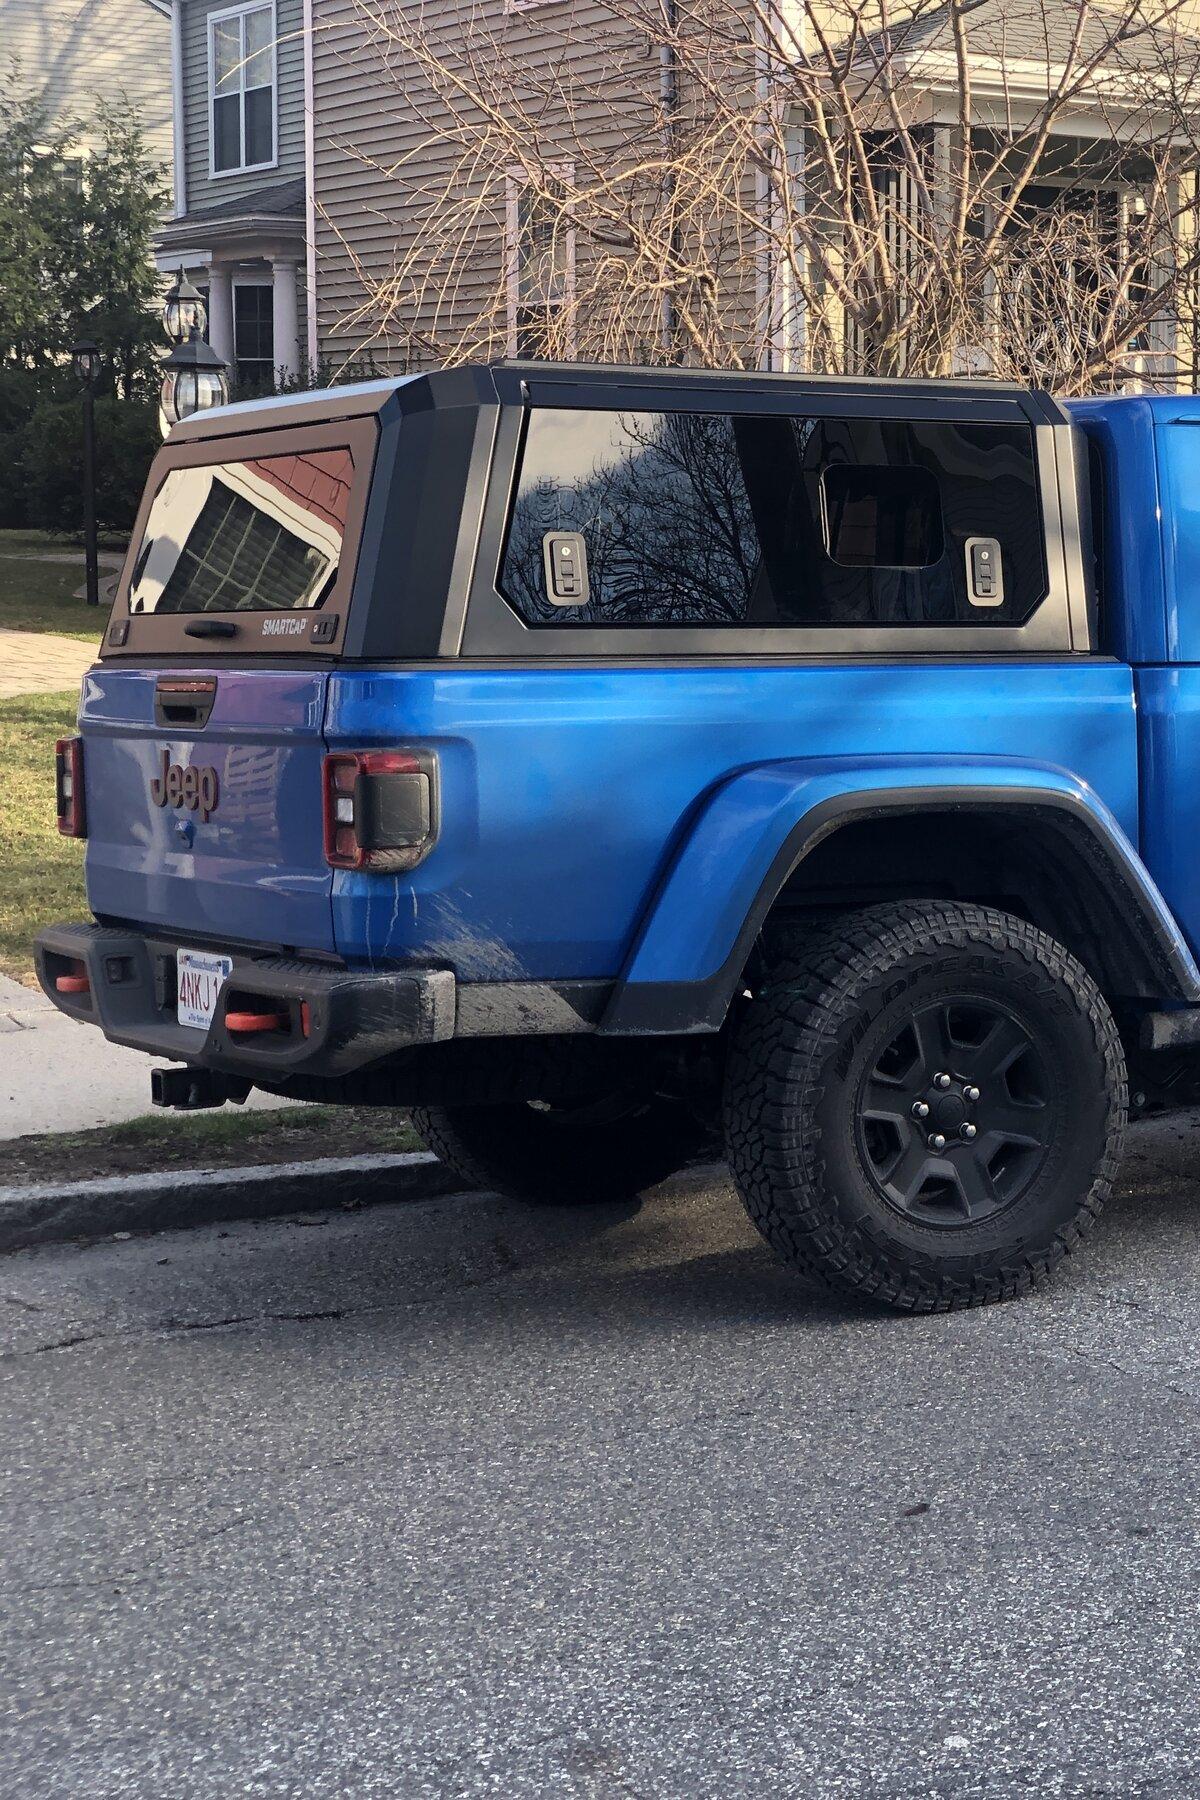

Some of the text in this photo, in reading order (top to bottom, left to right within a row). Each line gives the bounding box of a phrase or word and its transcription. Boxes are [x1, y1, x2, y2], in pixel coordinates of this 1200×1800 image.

[262, 618, 307, 635] SMARTCAP
[150, 749, 219, 824] Jeep
[180, 971, 210, 1011] 4NKJ
